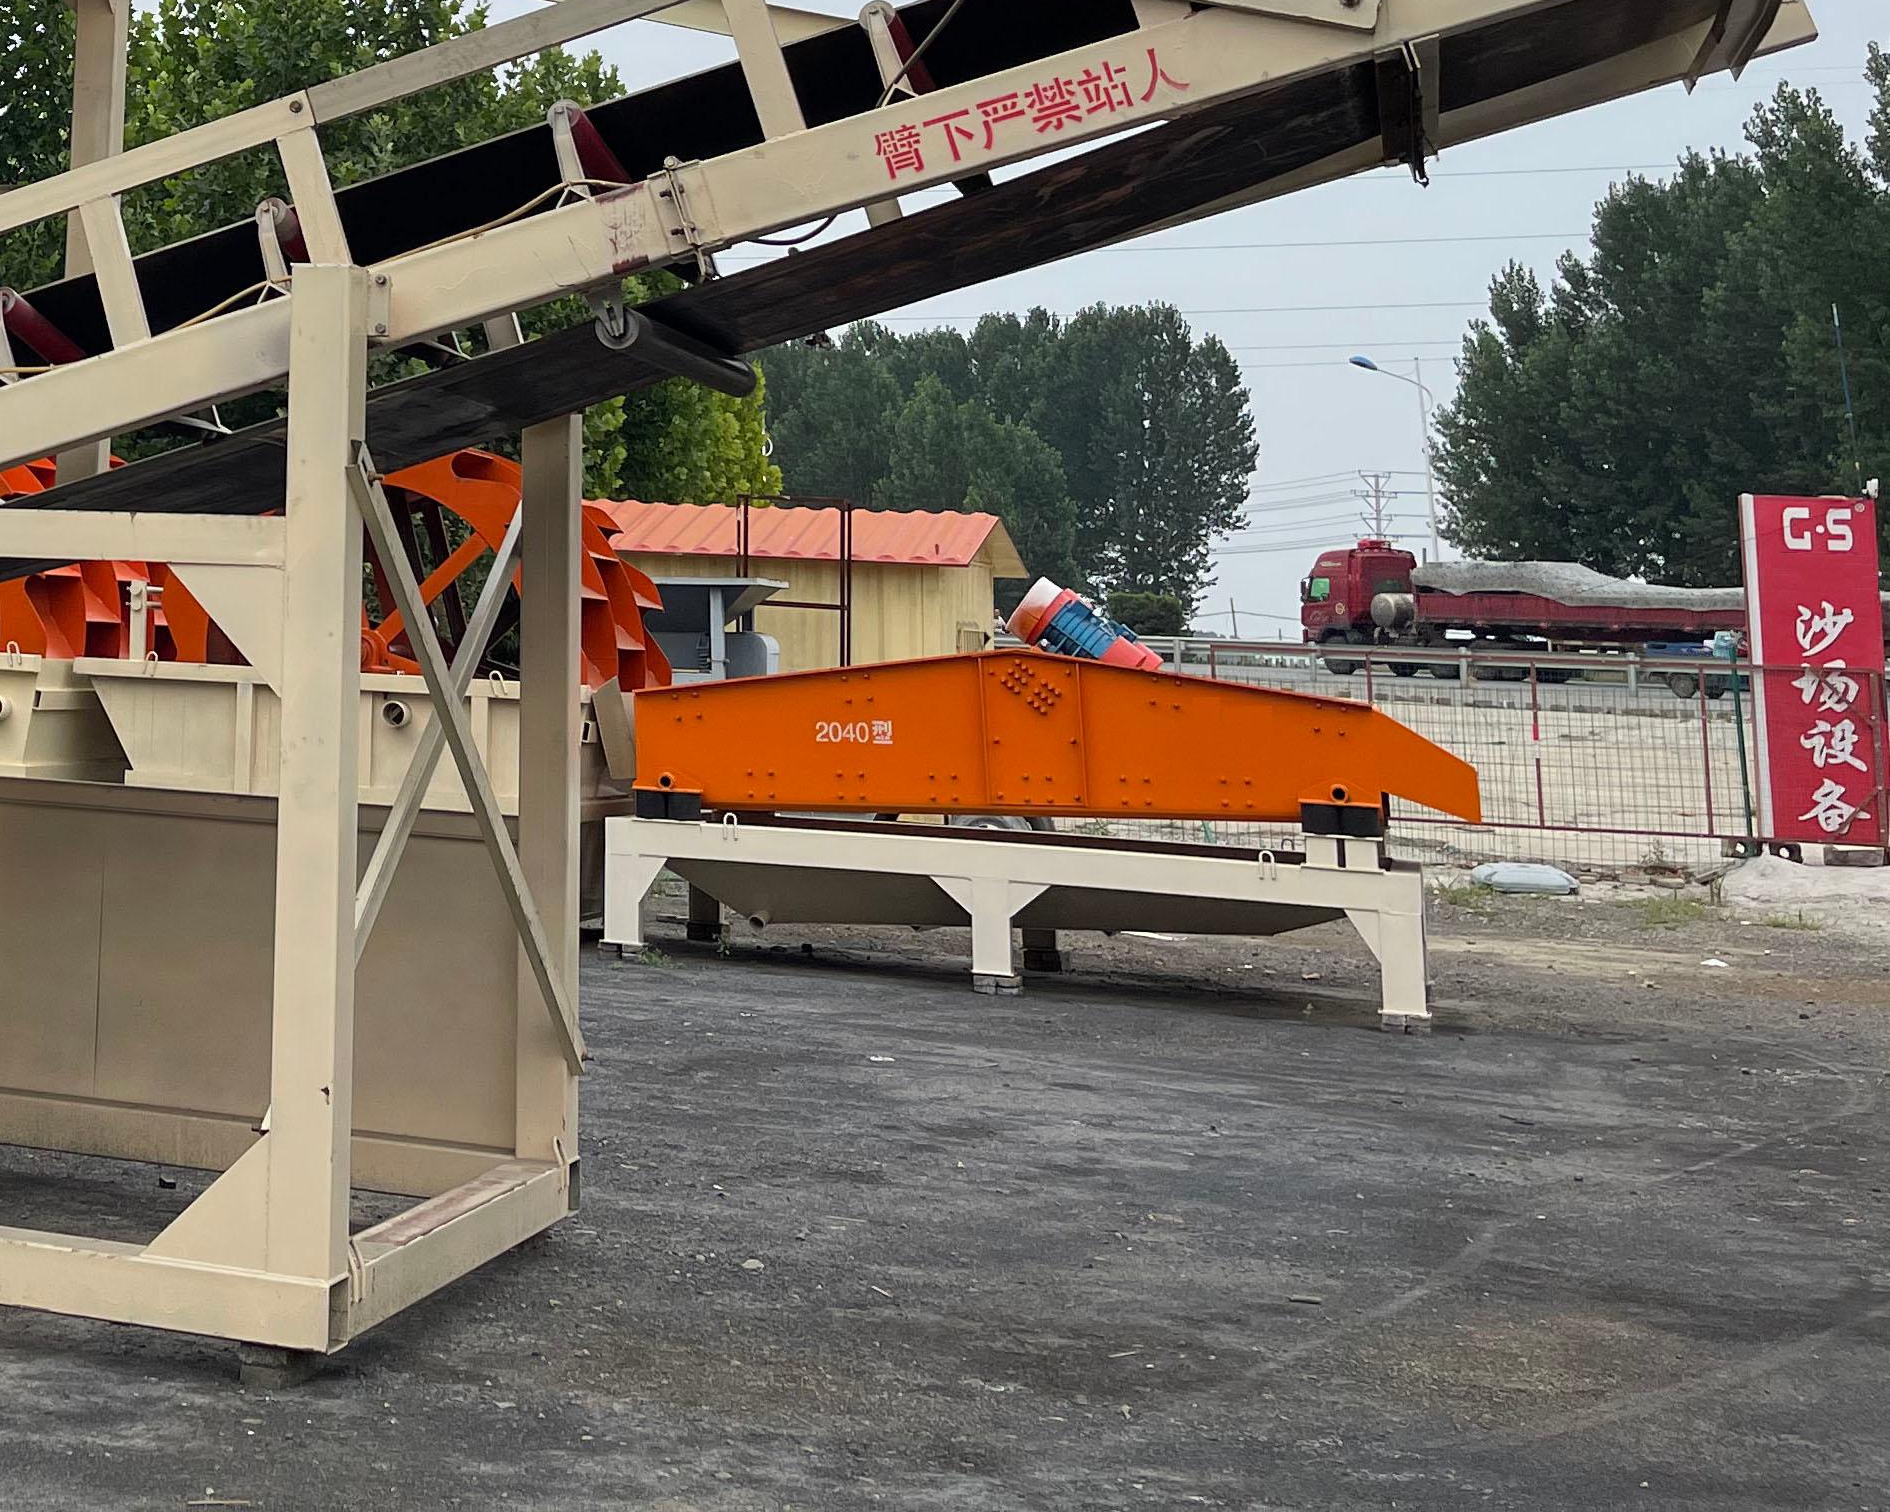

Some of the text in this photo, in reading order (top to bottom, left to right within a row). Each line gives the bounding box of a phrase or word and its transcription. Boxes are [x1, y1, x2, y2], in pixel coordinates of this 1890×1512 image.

[874, 48, 1190, 181] 臂下严禁站人
[1791, 600, 1871, 834] 沙场设备
